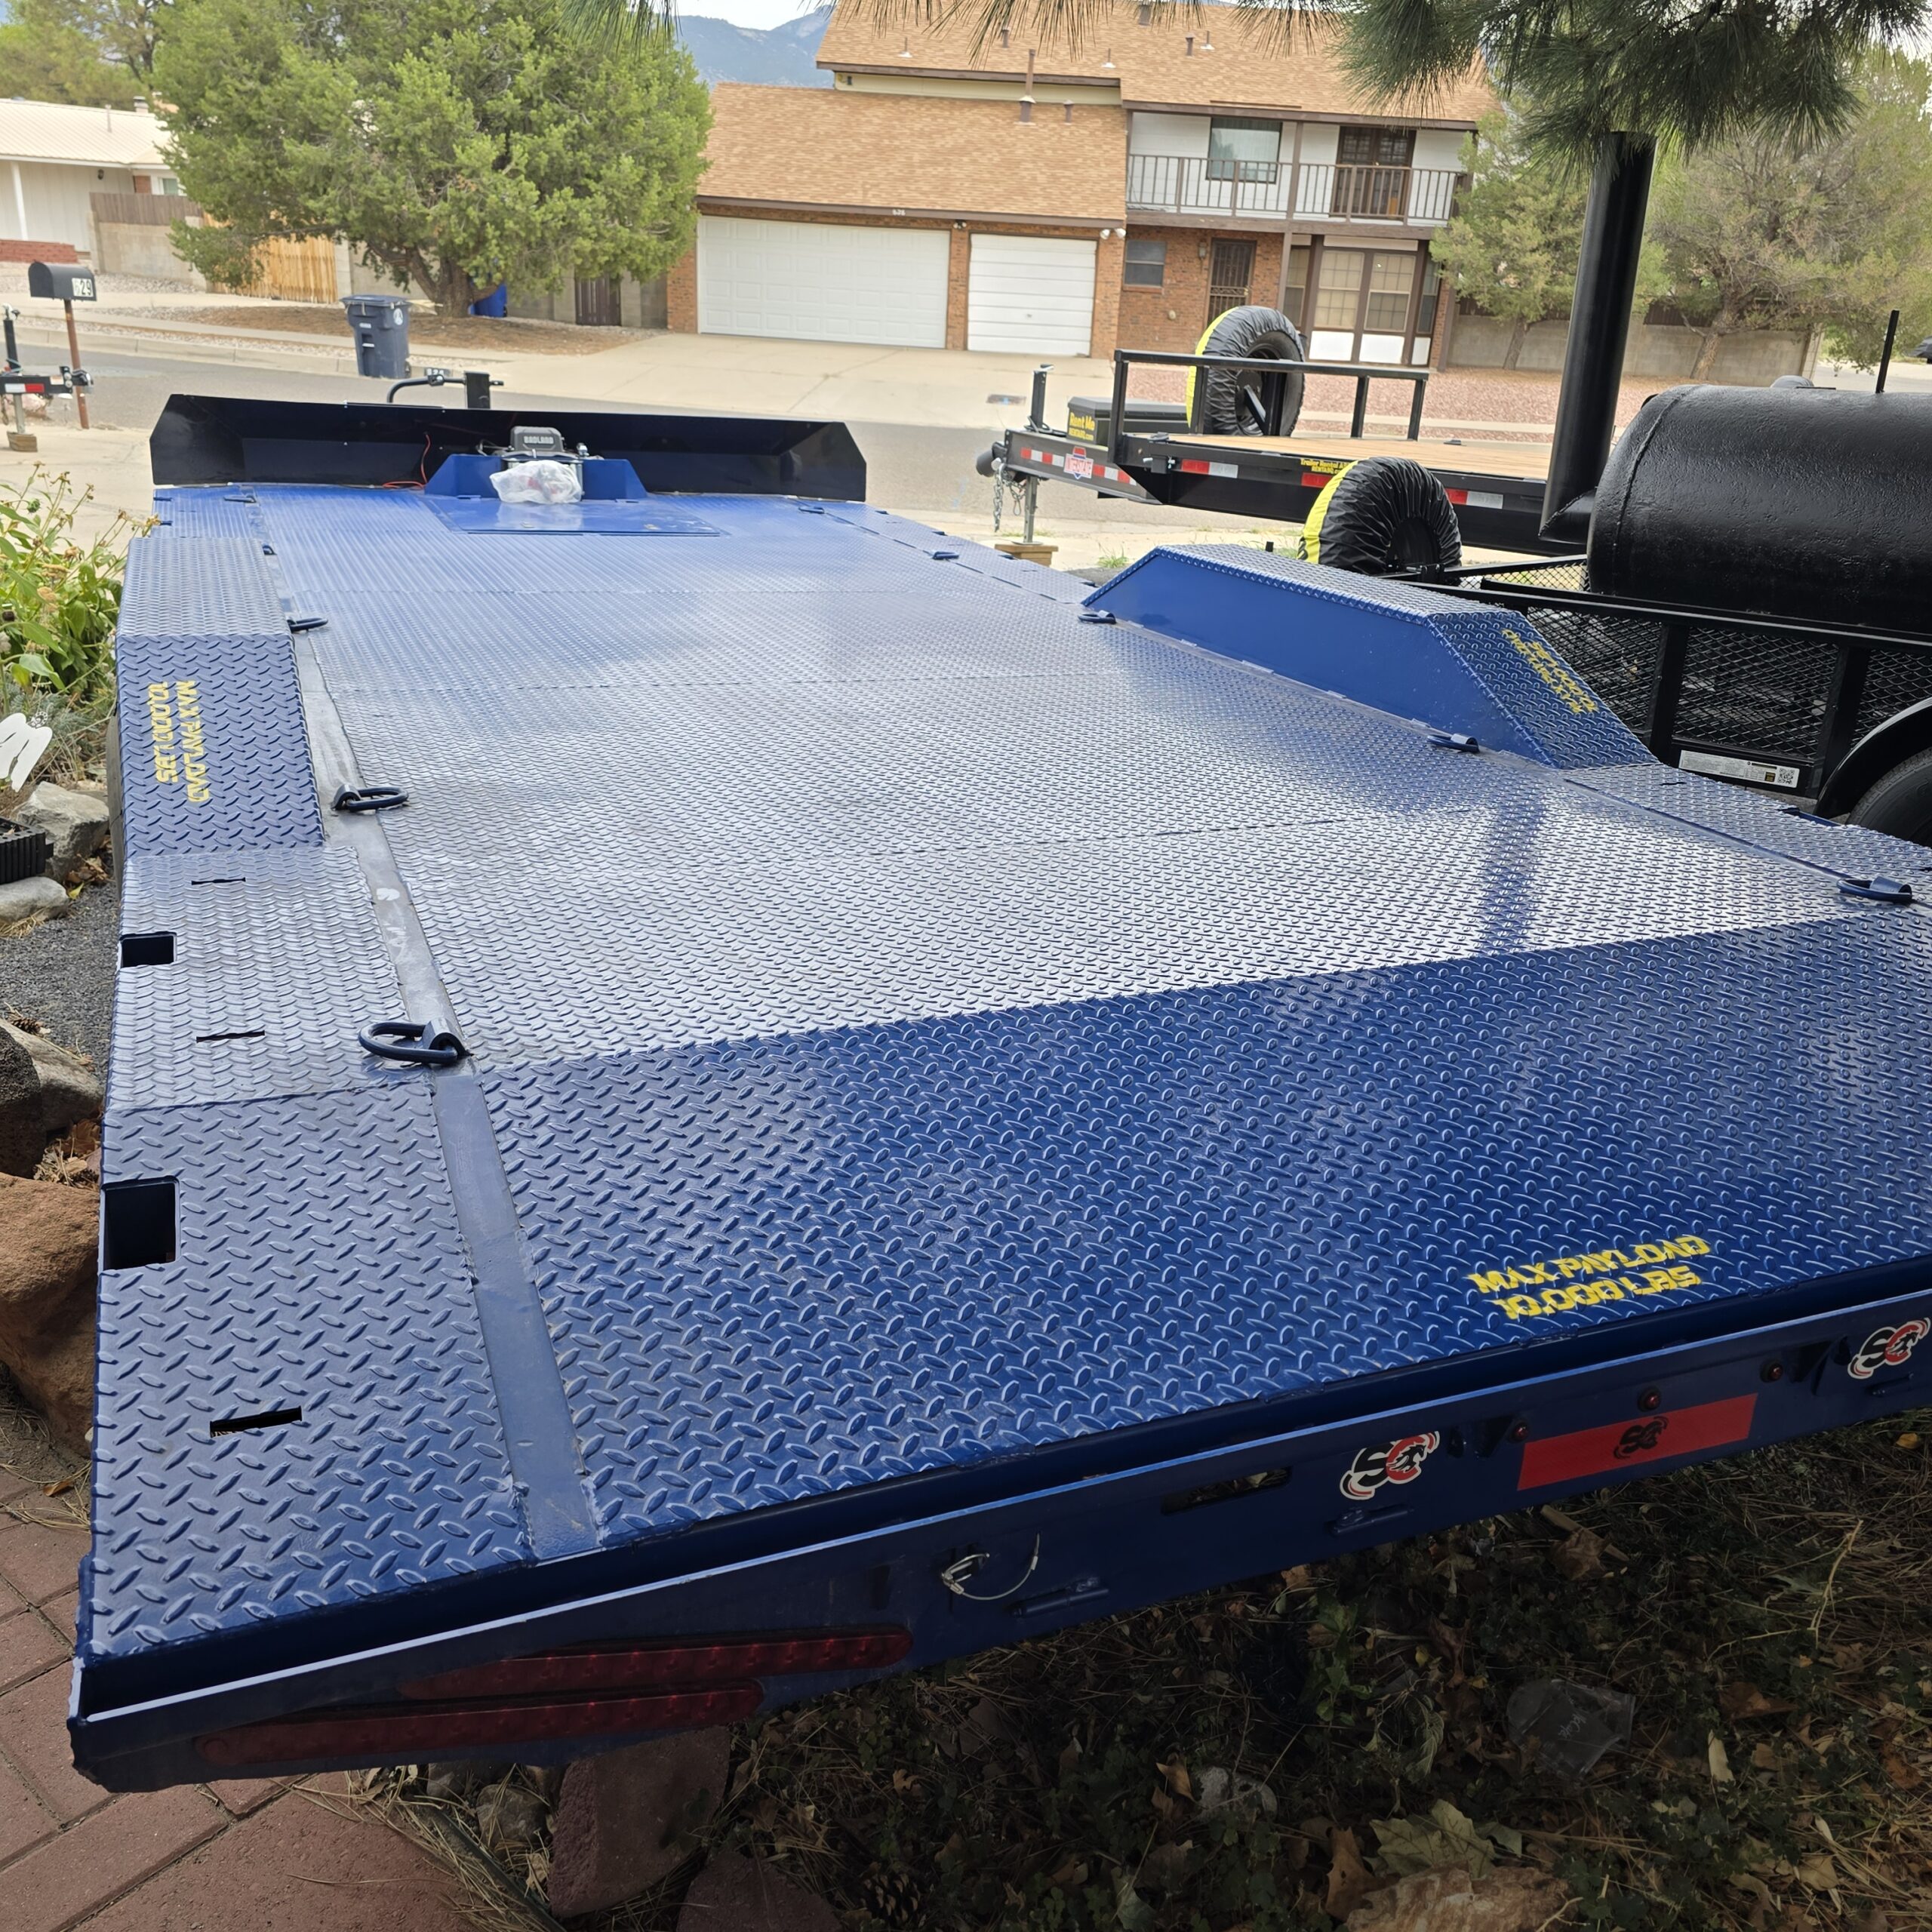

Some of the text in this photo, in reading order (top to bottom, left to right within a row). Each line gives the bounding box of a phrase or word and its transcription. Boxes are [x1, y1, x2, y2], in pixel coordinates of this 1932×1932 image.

[1069, 412, 1096, 431] Rent Me
[524, 435, 554, 445] BADLAND
[1066, 456, 1092, 476] INTERSTATE
[1300, 458, 1319, 467] Trailer
[1319, 460, 1339, 469] Rental
[175, 681, 209, 802] MAX PAYLOAD
[154, 744, 178, 783] LBS
[1468, 1236, 1710, 1294] MAX PAYLOAD
[1620, 1266, 1701, 1295] LBS
